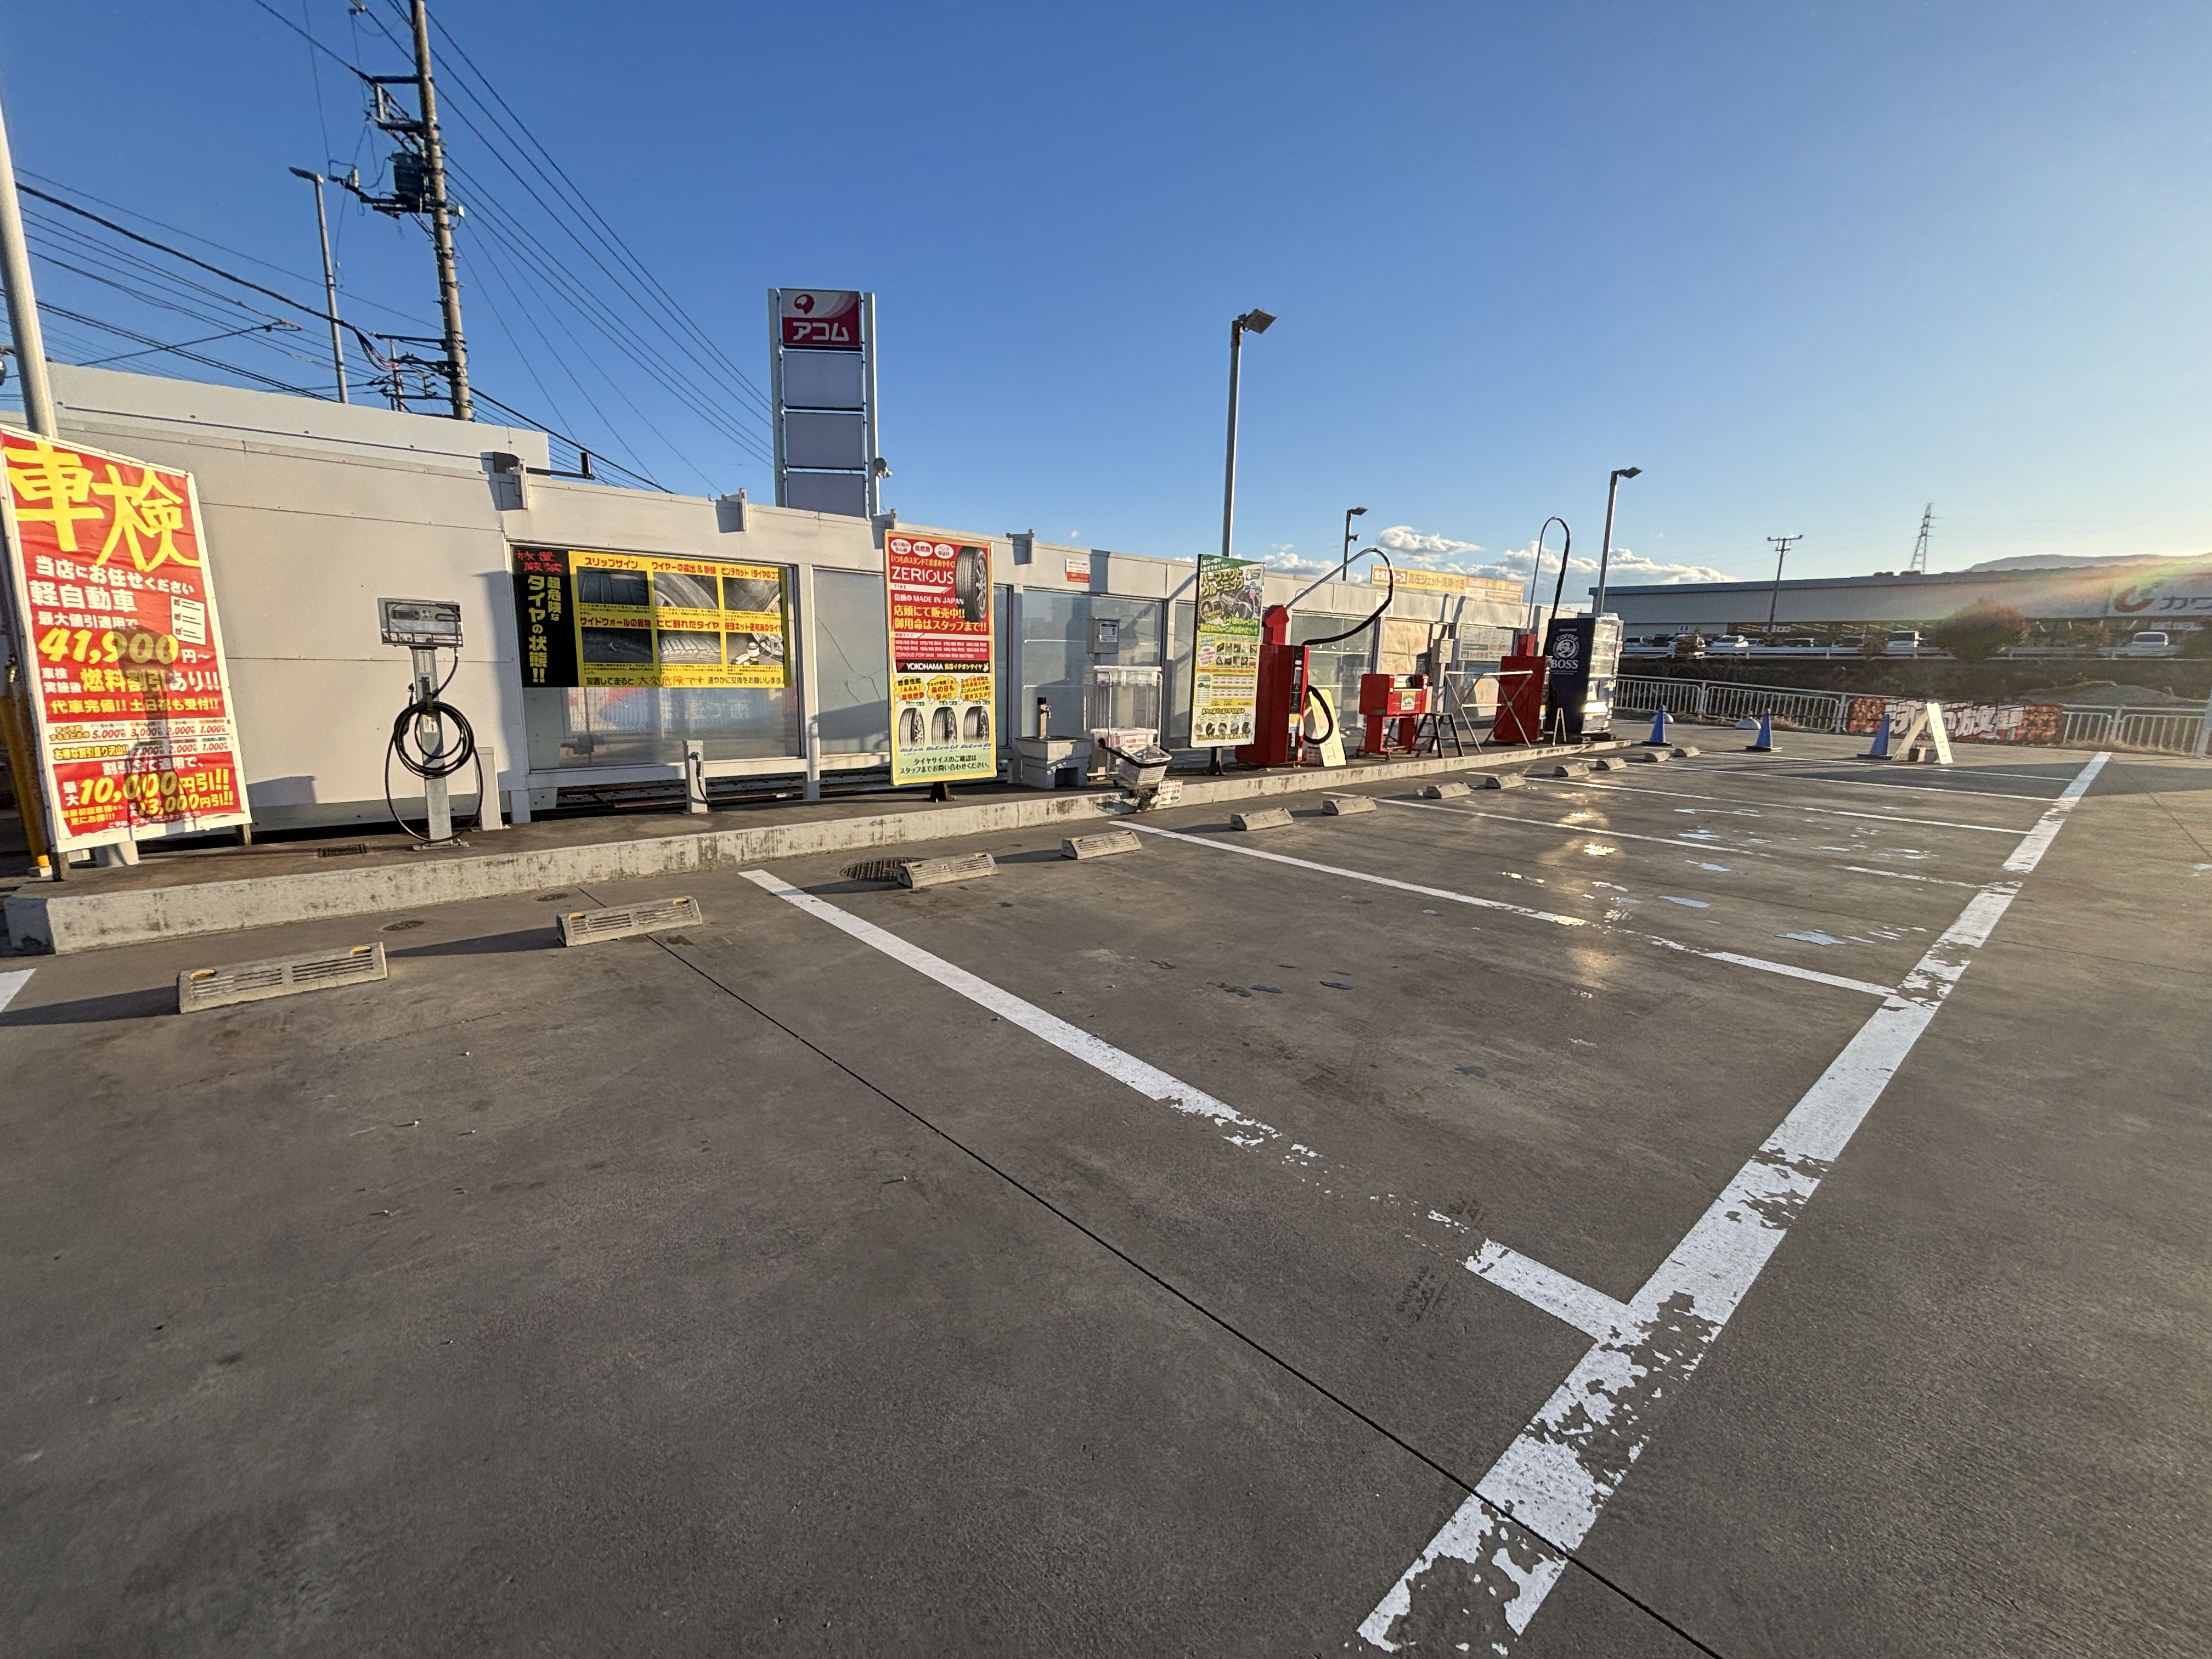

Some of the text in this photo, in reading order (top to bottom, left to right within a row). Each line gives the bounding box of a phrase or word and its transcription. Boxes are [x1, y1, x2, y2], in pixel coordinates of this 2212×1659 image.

[792, 321, 849, 341] アコム
[3, 439, 201, 571] 車検
[584, 557, 638, 569] スリップサイン
[36, 555, 195, 595] 当店にお任せください
[891, 566, 954, 584] ZERIOUS
[29, 580, 137, 612] 軽自動車
[547, 576, 562, 622] 超危険な
[913, 595, 932, 603] MADE
[943, 597, 964, 605] JAPAN
[894, 604, 966, 620] 店頭にて販売中!!
[527, 575, 548, 683] タイヤの状態!!
[580, 617, 651, 628] サイドウォールの異物
[657, 619, 719, 630] ヒビ割れたタイヤ
[894, 618, 986, 632] 御用命はスタッフまで!!
[906, 663, 944, 671] YOKOHAMA
[1551, 659, 1578, 669] BOSS
[586, 676, 634, 685] 放置して走ると
[637, 675, 704, 686] 大変危険です
[932, 685, 954, 693] 雨の日も
[914, 755, 977, 766] タイヤサイズのご確認は
[899, 762, 990, 775] スタッフまでお問い合わせください。
